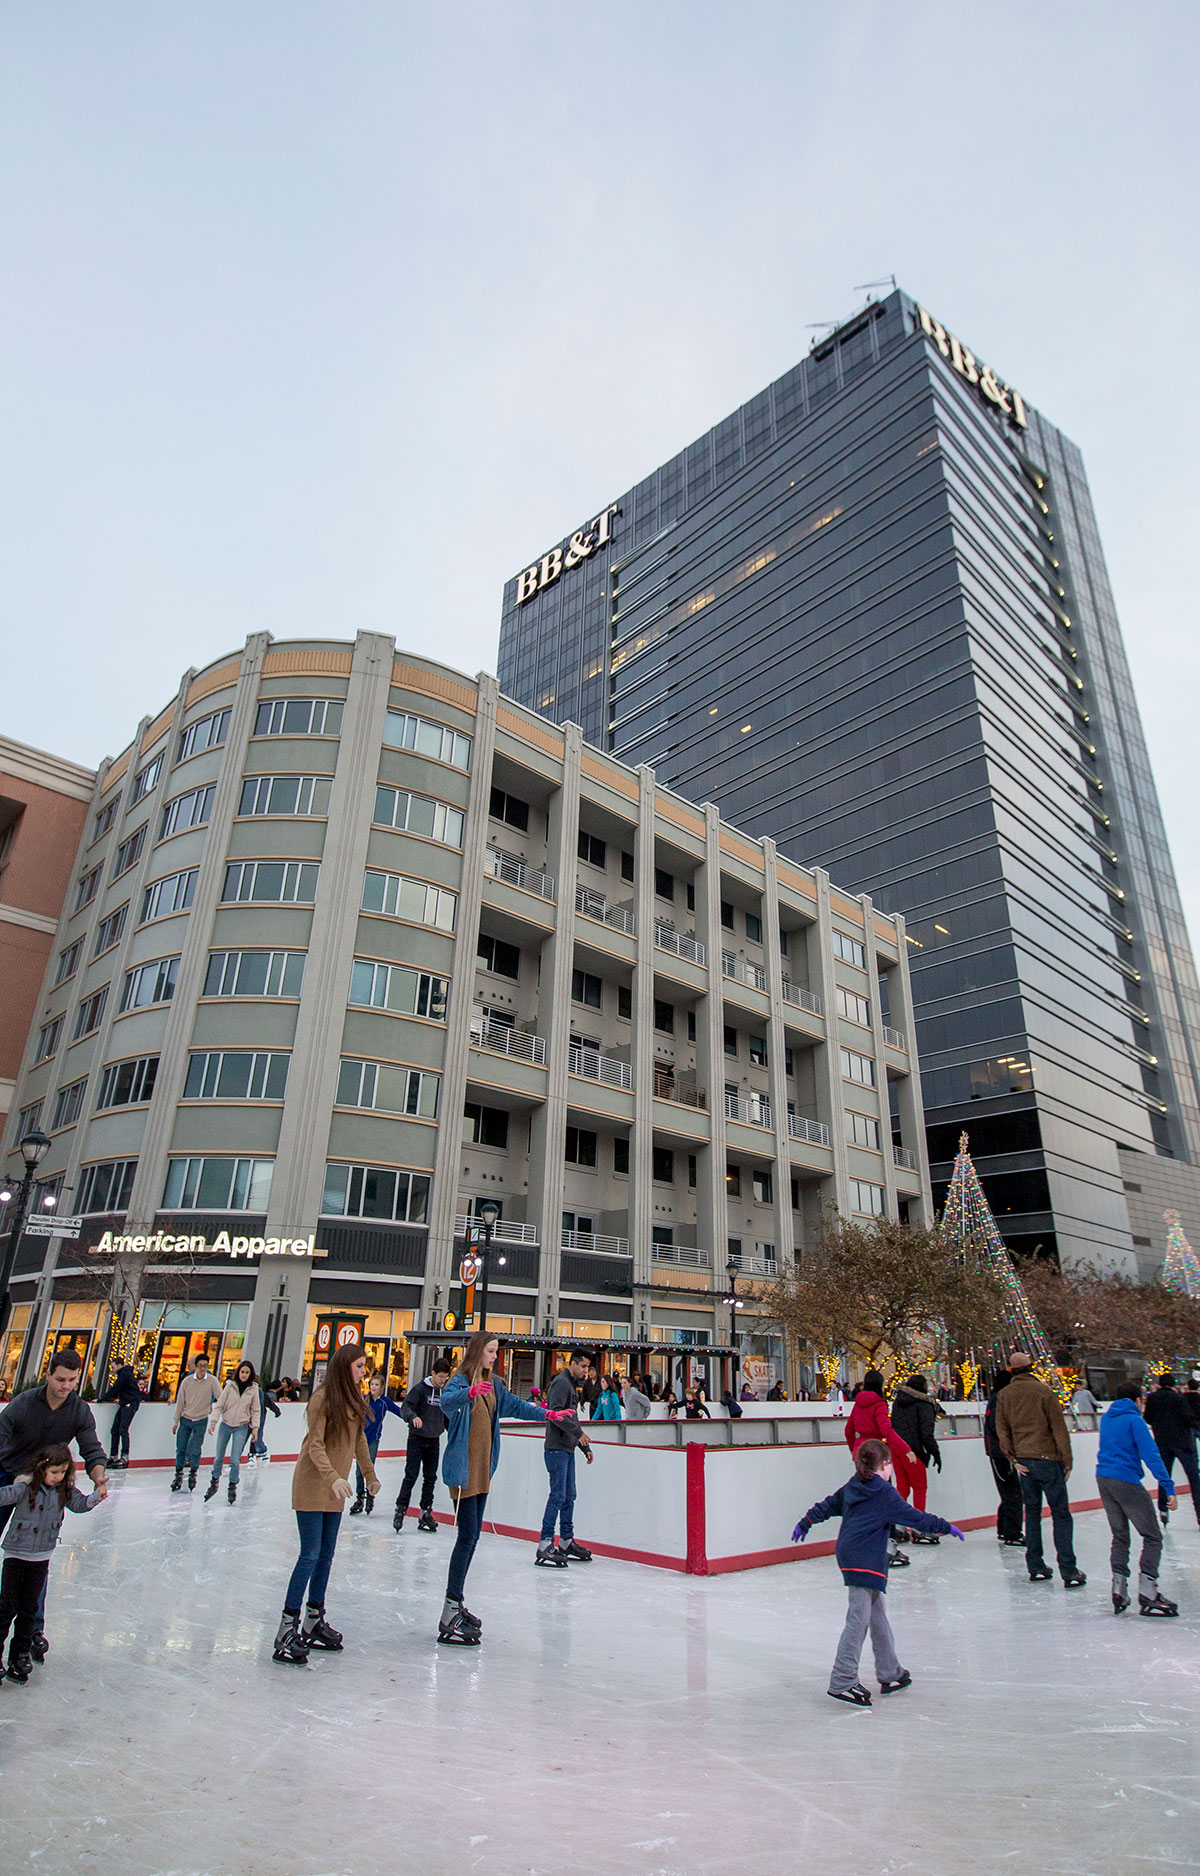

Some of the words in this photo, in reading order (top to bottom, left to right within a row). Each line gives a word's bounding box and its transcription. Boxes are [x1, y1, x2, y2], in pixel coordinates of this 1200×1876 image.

[919, 308, 1029, 430] BB&T
[514, 503, 618, 607] BB&T
[27, 1227, 54, 1236] Parking
[97, 1230, 206, 1253] American
[211, 1231, 315, 1258] Apparel
[463, 1261, 475, 1279] 12
[446, 1316, 454, 1328] 12
[321, 1329, 329, 1345] 12
[342, 1329, 355, 1345] 12
